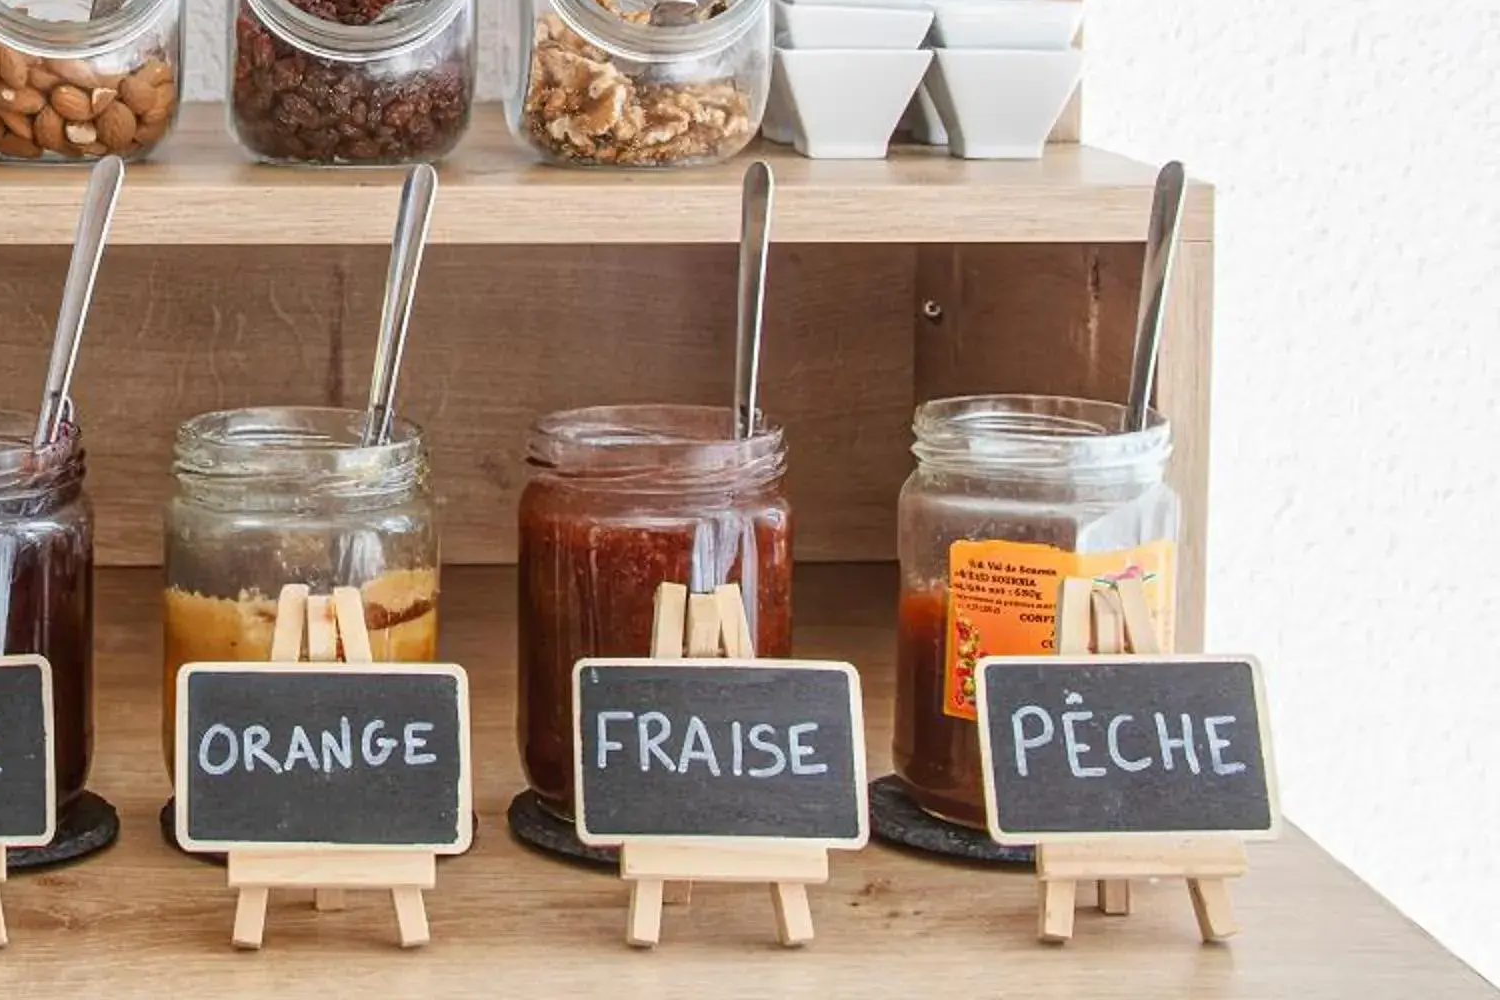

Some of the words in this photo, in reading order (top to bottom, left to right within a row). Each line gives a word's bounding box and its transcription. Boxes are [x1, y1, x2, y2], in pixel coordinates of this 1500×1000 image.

[1019, 613, 1056, 624] CONFI
[199, 715, 437, 776] ORANGE
[597, 711, 828, 778] FRAISE
[1011, 692, 1247, 778] PÊCHE
